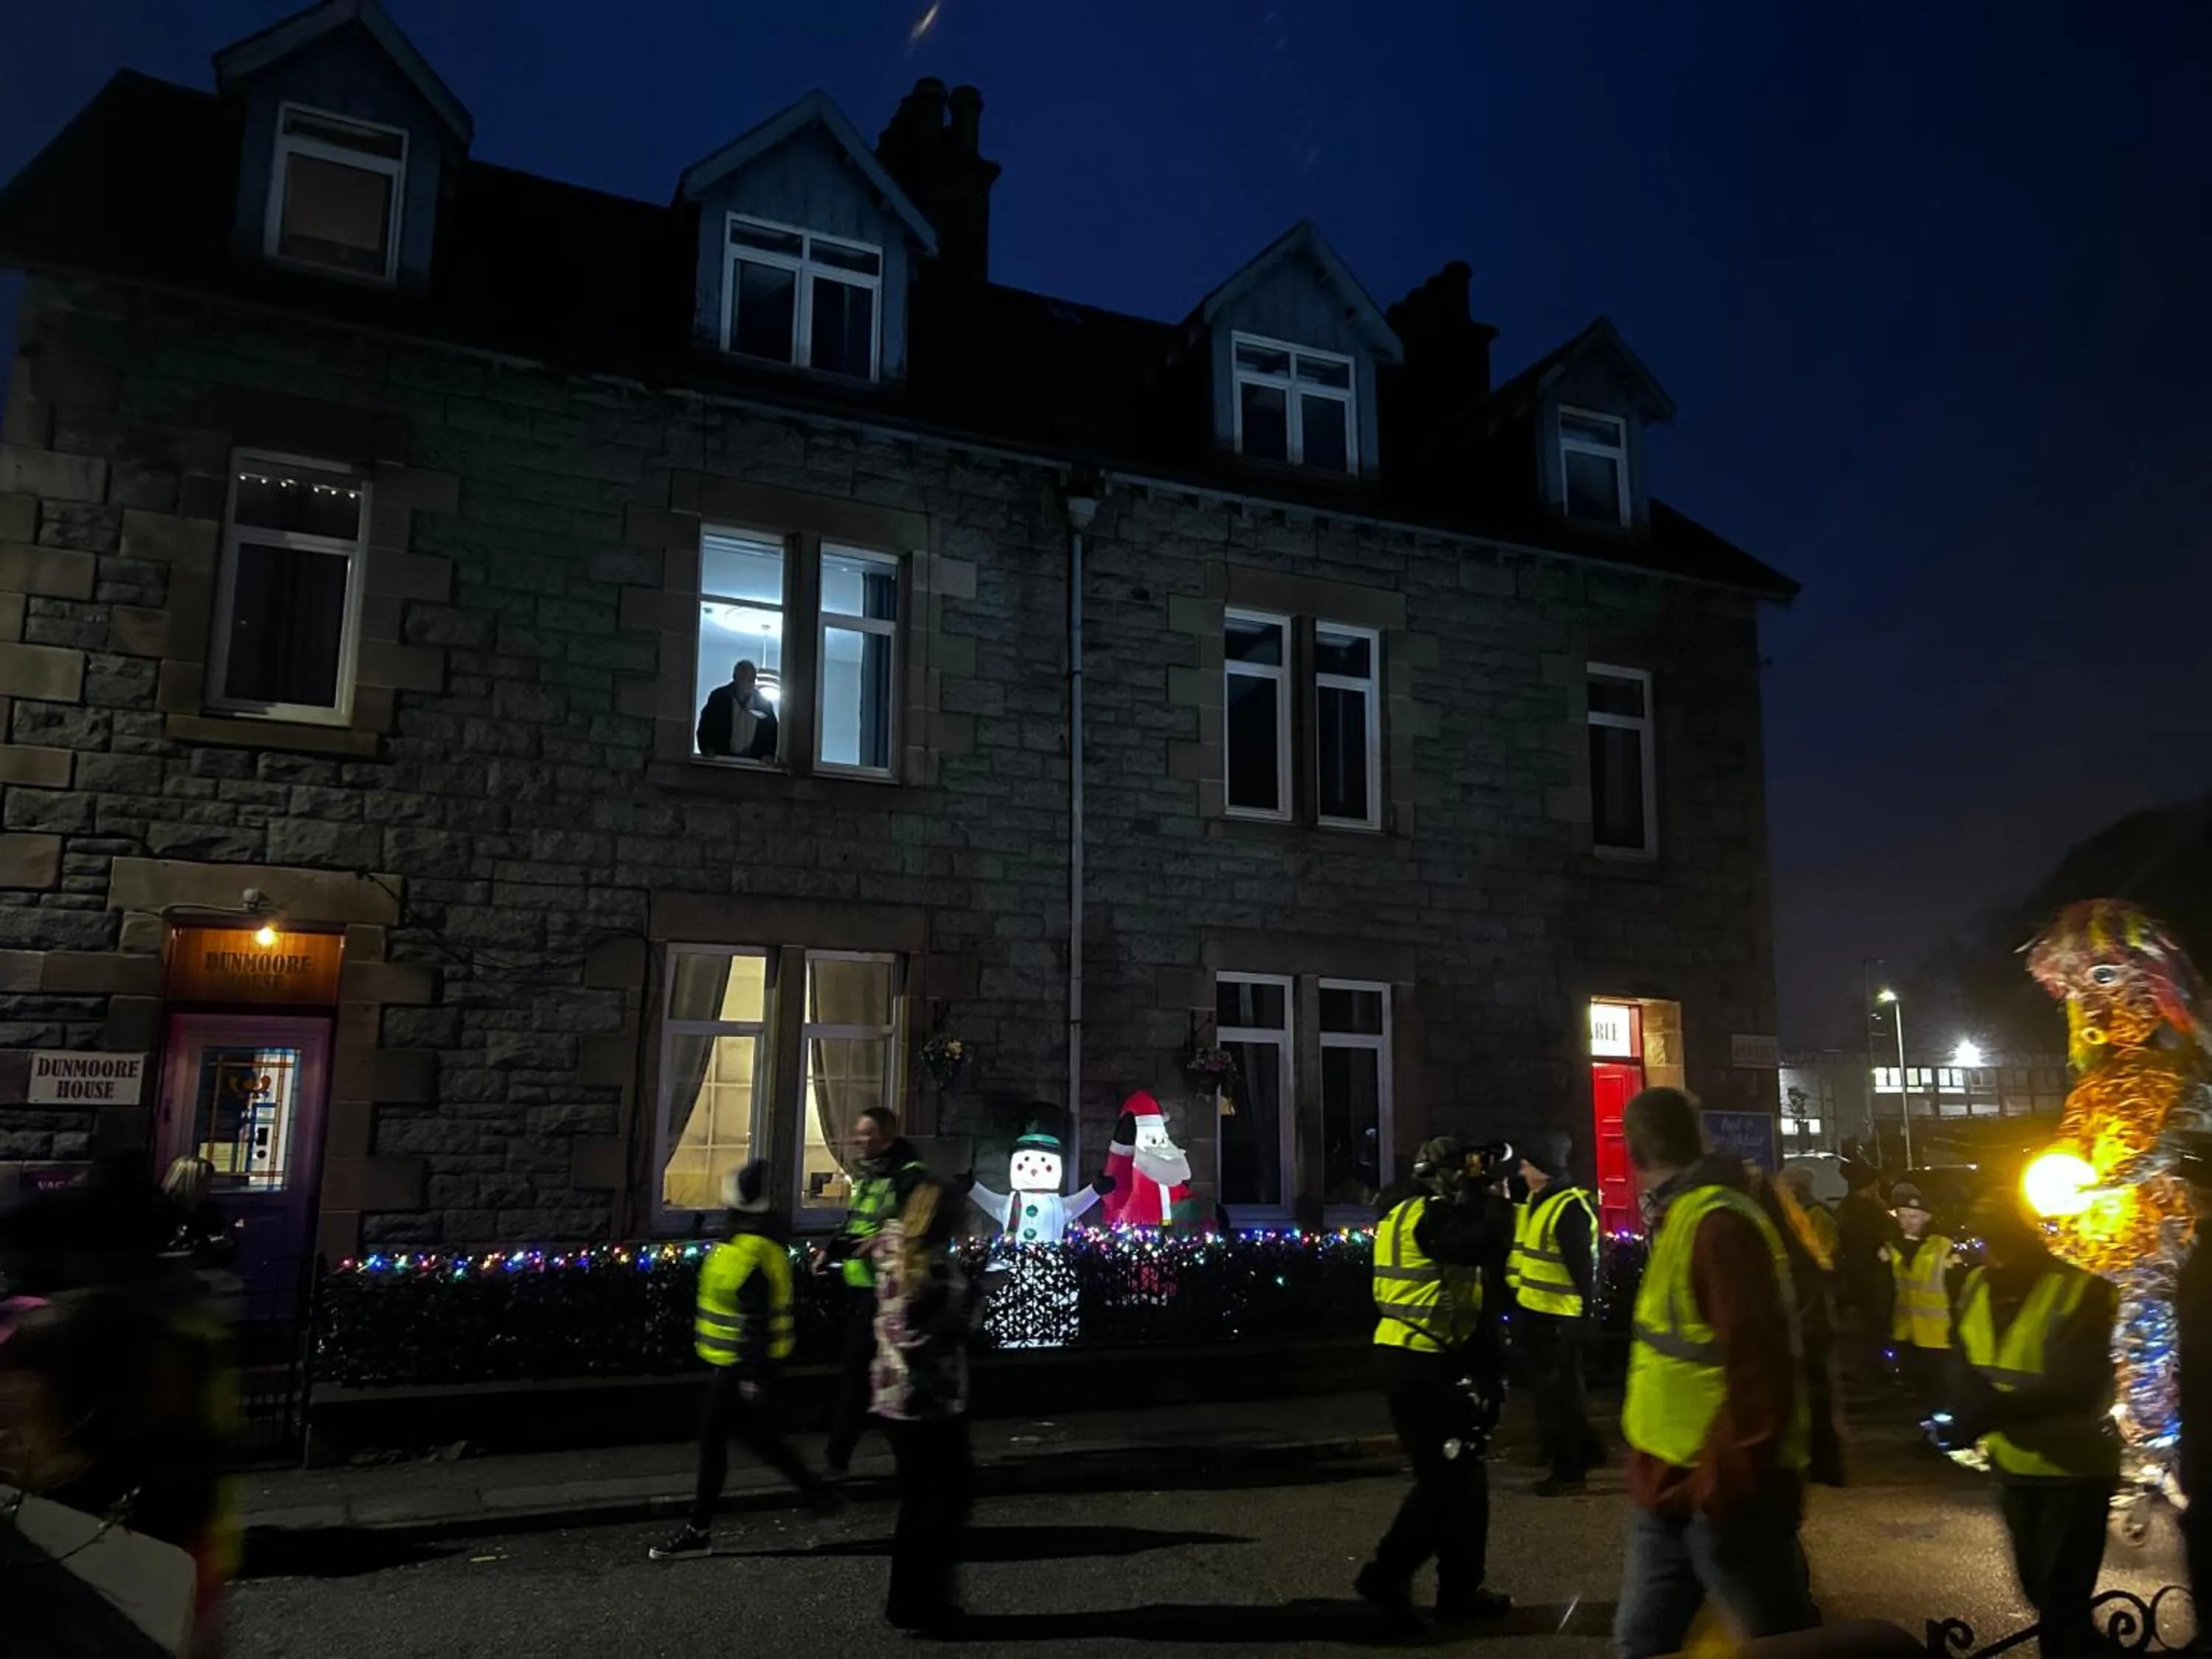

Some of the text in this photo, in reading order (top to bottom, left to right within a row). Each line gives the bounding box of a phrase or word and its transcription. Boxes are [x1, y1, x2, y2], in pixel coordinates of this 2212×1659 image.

[204, 951, 313, 974] DUNMOORE
[38, 1057, 141, 1078] DUNMOORE
[56, 1080, 116, 1099] HOUSE
